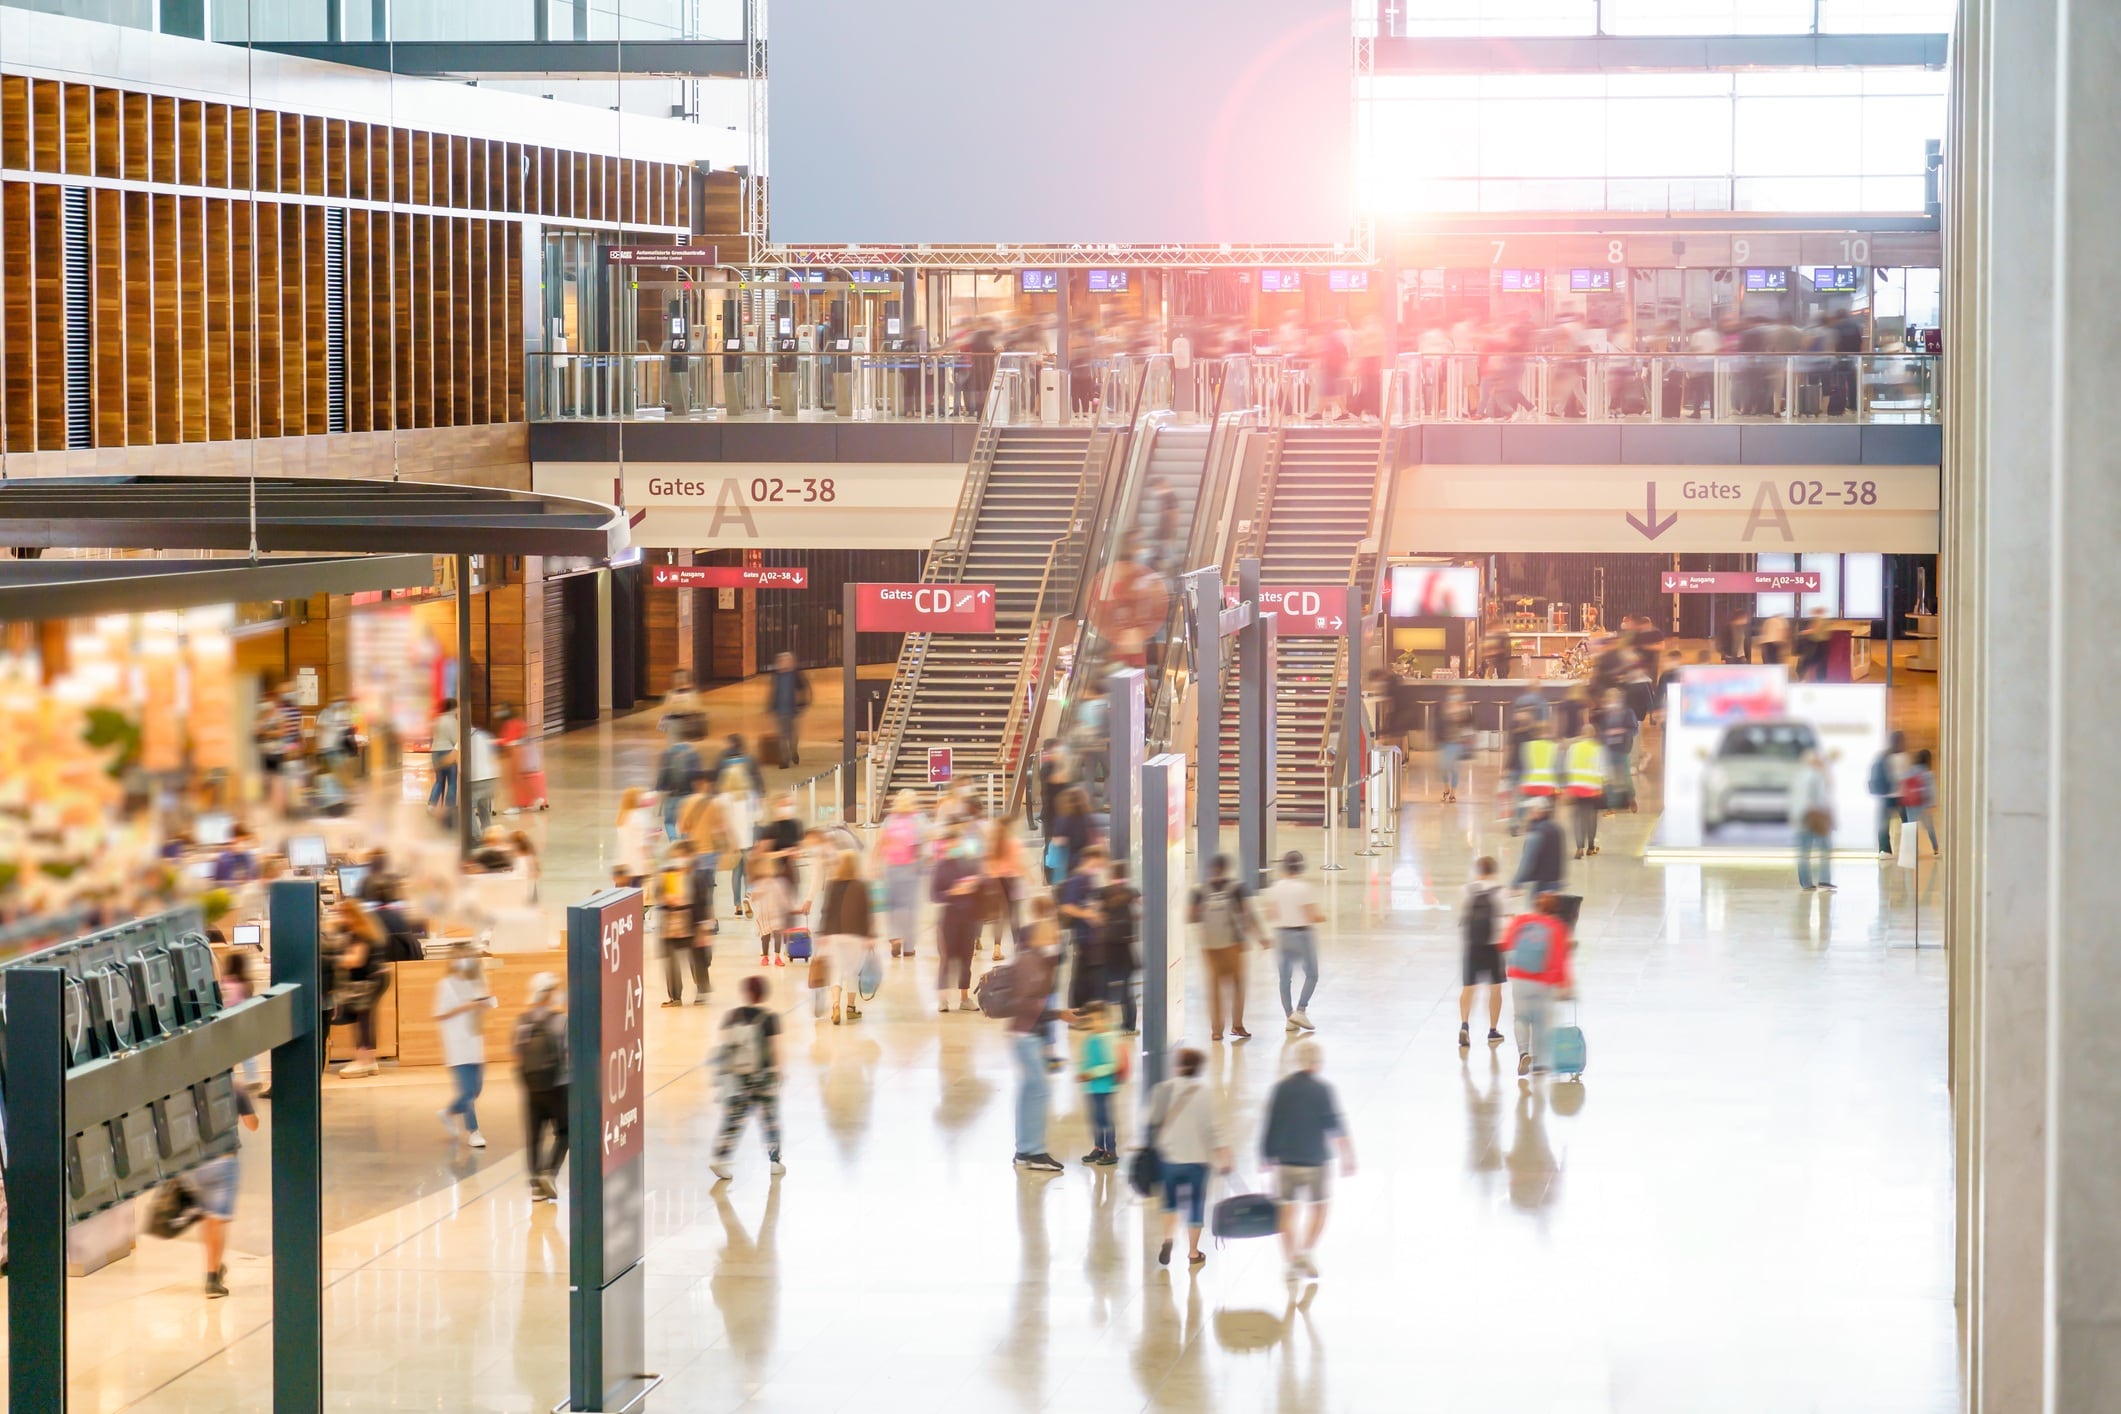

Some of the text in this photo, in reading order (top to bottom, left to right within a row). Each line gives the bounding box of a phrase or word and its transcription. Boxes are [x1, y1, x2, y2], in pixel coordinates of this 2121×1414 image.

[1490, 240, 1505, 264] 7
[1607, 240, 1624, 264] 8
[1734, 239, 1750, 264] 9
[1839, 239, 1869, 263] 10
[648, 478, 836, 538] Gates A 02–38
[1682, 480, 1878, 542] Gates A 02–38
[680, 571, 705, 579] Ausgang
[759, 572, 769, 584] A
[1689, 576, 1715, 584] Ausgang
[1771, 577, 1782, 589] A
[880, 588, 952, 613] Gates CD
[1258, 591, 1321, 616] ates CD
[611, 920, 620, 974] B
[625, 978, 635, 1032] A
[608, 1047, 627, 1104] CD
